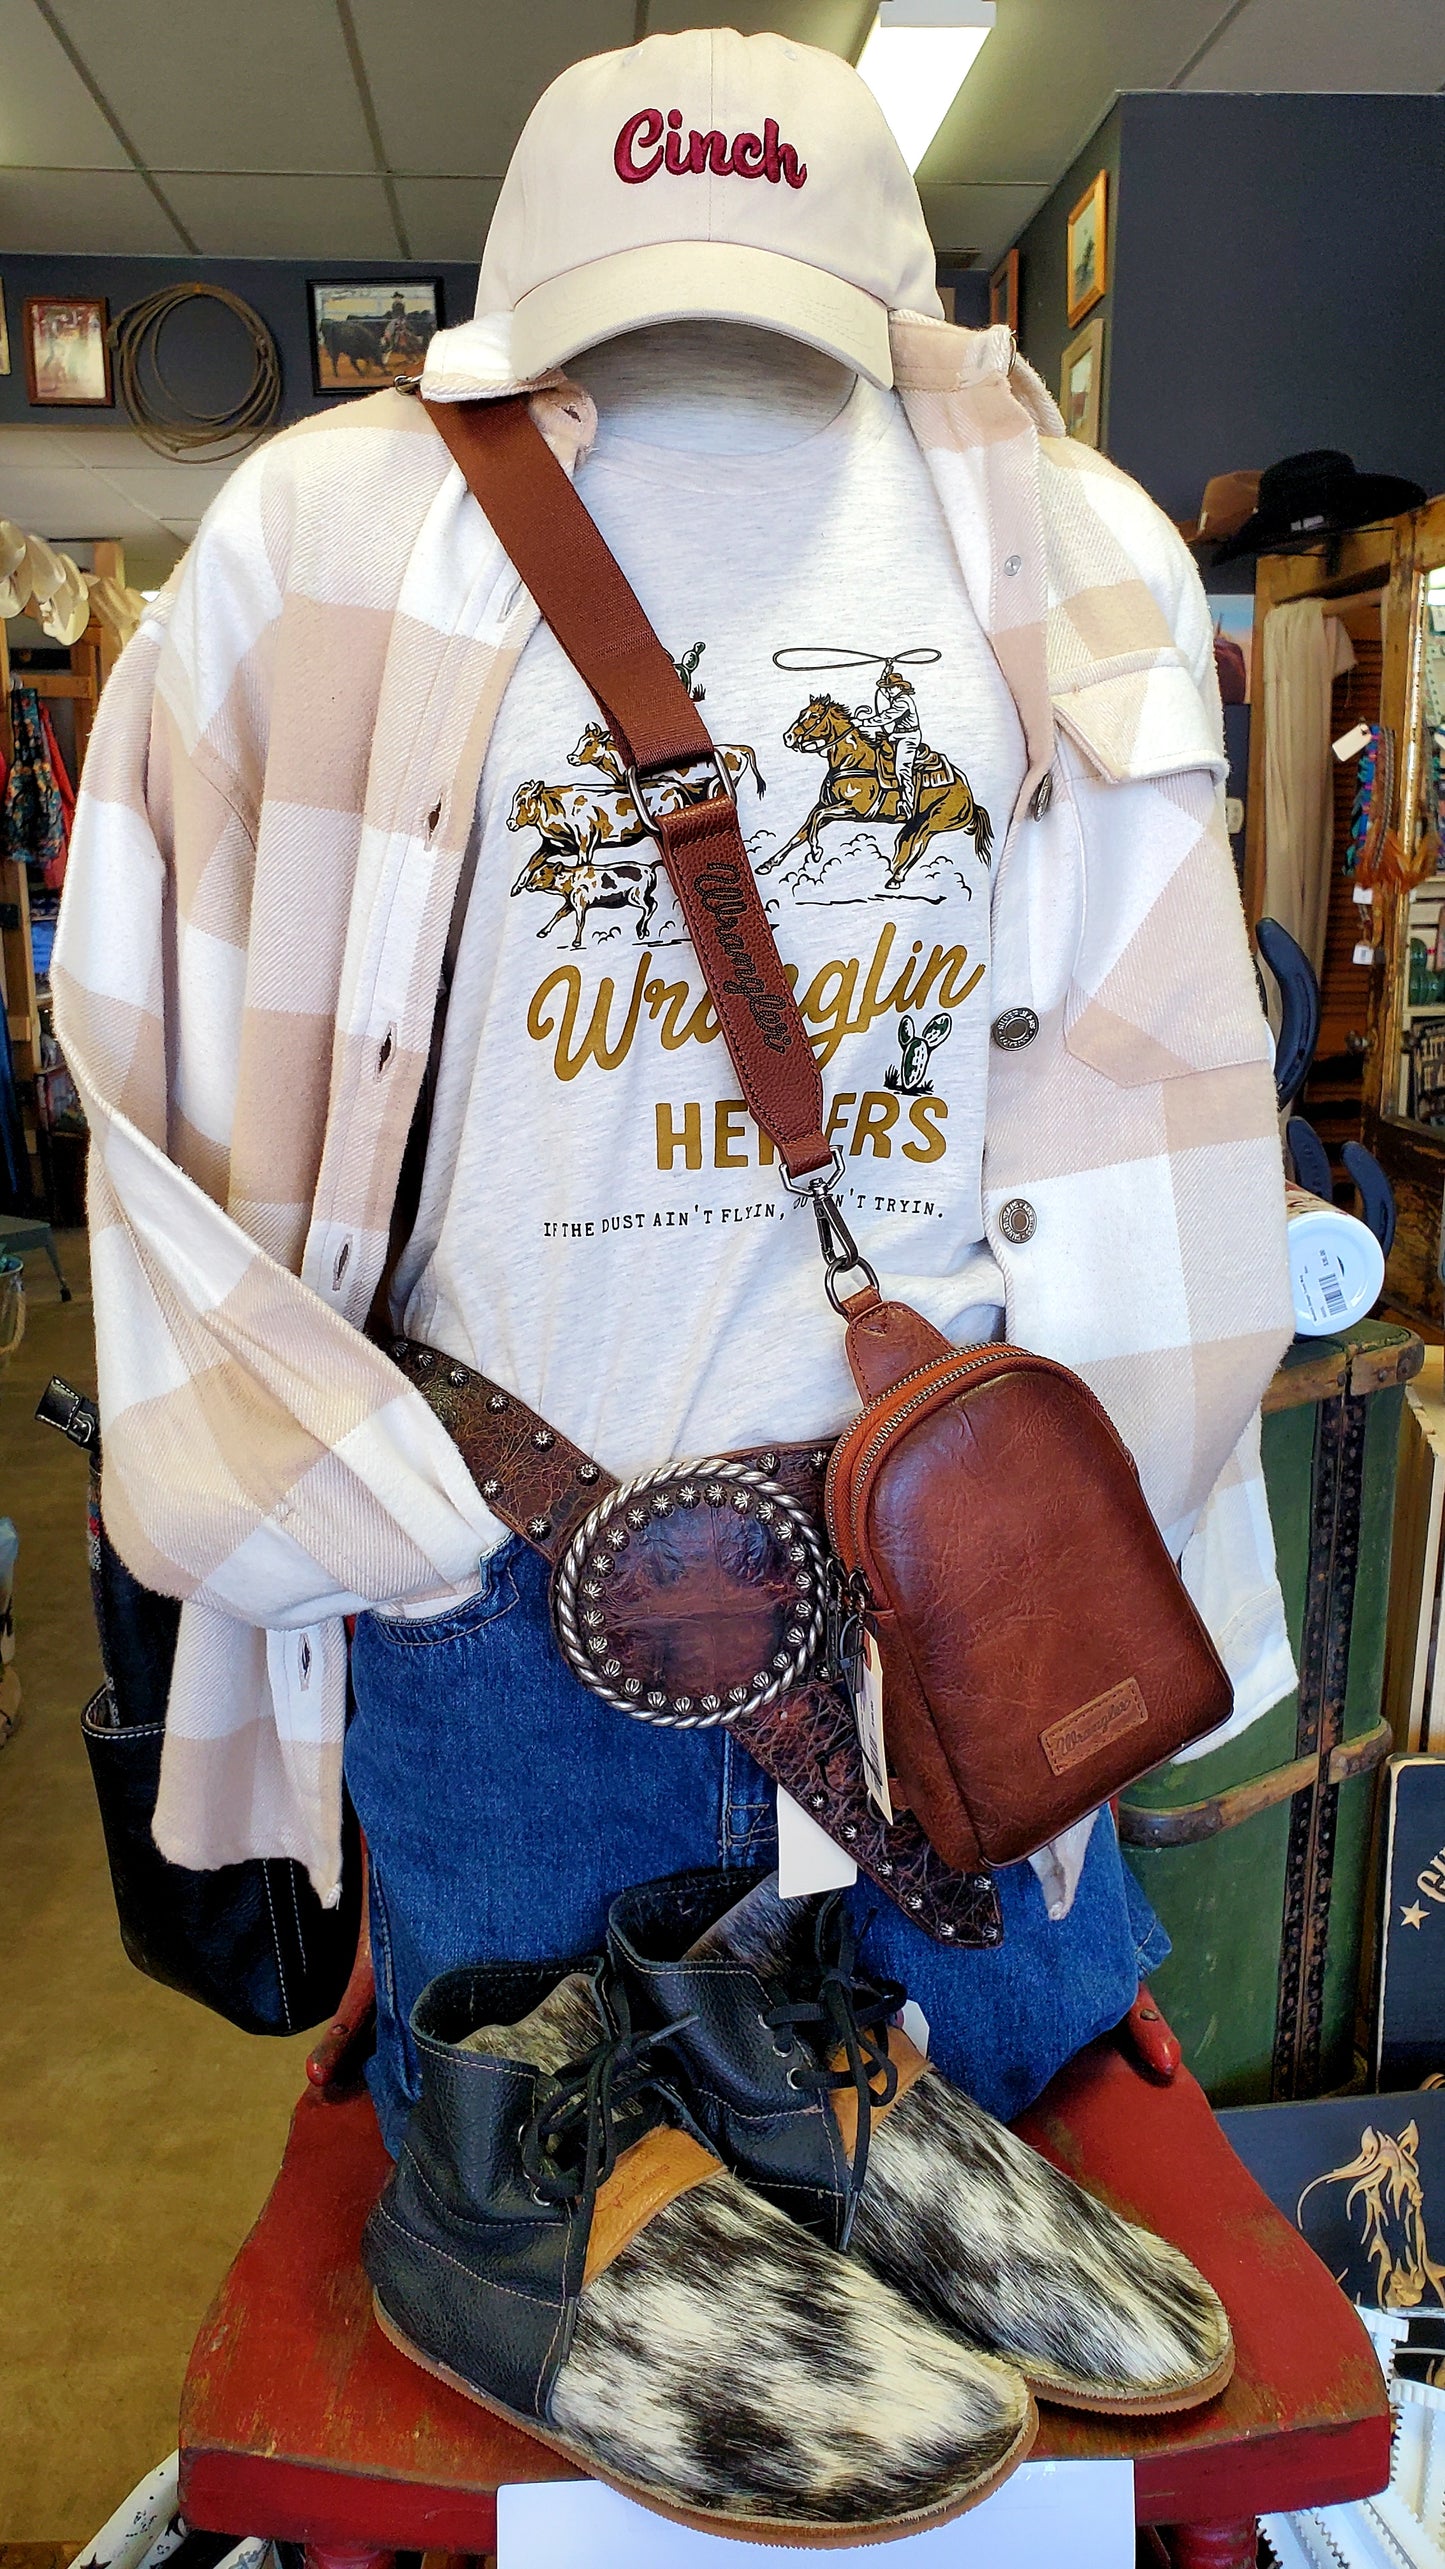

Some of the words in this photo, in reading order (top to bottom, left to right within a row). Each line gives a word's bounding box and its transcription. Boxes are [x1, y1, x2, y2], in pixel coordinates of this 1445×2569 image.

[614, 108, 807, 189] Cinch
[544, 1222, 558, 1237] IF
[562, 1222, 595, 1237] THE
[602, 1213, 645, 1233] DUST
[653, 1204, 713, 1226] AIN'T
[721, 1203, 786, 1220] FLYIN,
[875, 1197, 943, 1218] TRYIN.
